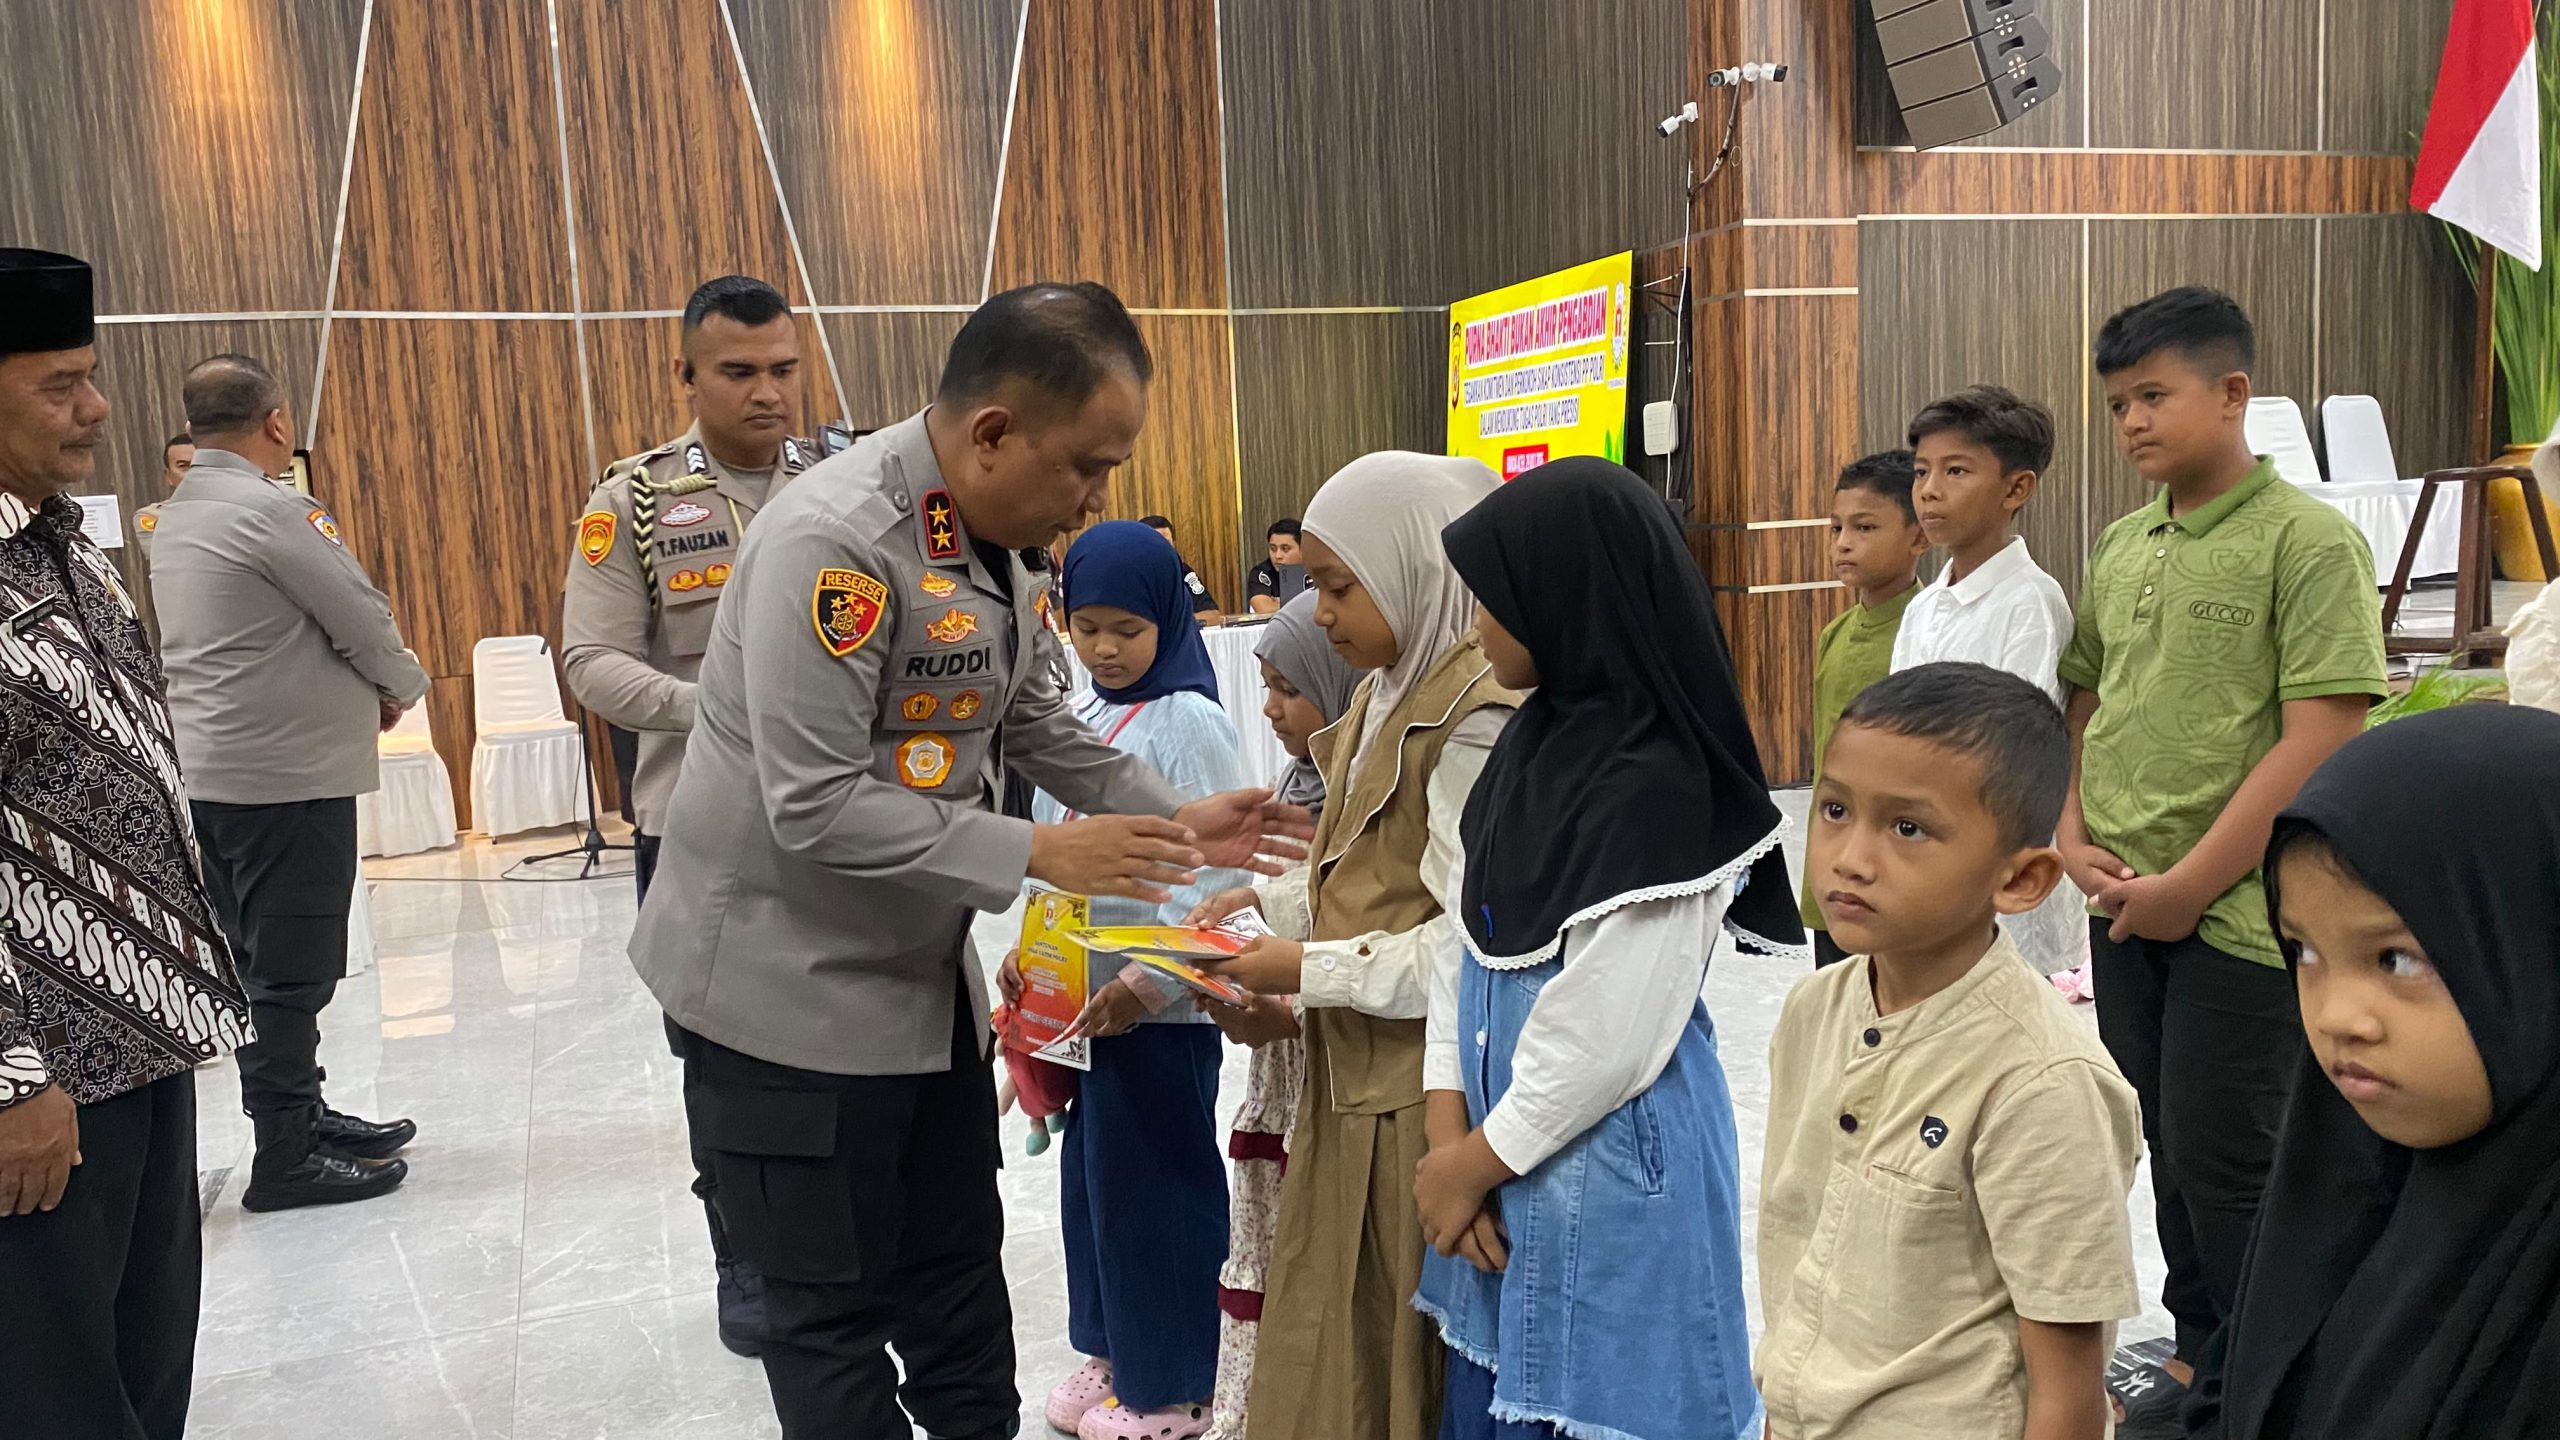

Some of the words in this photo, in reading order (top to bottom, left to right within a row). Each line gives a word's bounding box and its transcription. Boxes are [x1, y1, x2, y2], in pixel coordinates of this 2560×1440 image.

[1486, 316, 1511, 361] BHAKTI
[1511, 308, 1535, 355] BUKAN
[1535, 303, 1556, 349] AKHIR
[1558, 289, 1607, 344] PENGABDIAN
[656, 530, 729, 558] T.FAUZAN
[824, 571, 884, 601] RESERSE
[2193, 603, 2250, 625] GUCCI
[905, 646, 991, 678] RUDDI
